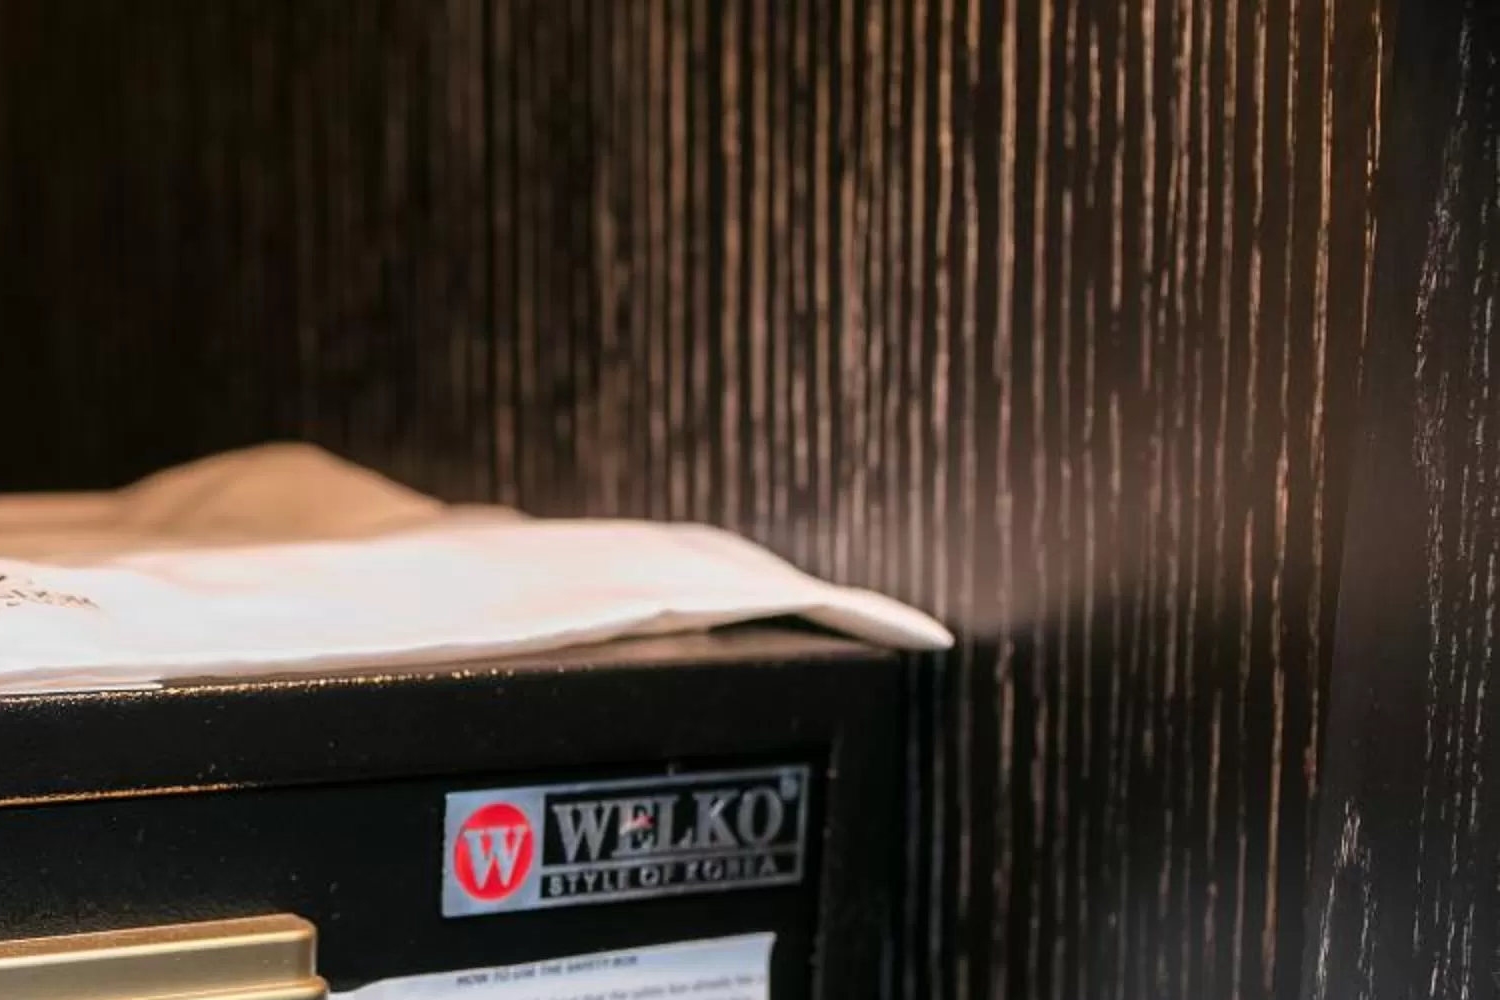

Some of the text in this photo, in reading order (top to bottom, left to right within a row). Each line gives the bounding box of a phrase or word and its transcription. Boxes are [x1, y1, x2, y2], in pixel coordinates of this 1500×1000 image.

[553, 785, 784, 865] WELKO
[549, 853, 778, 897] STYLE OF KOREA
[457, 974, 487, 986] HOW
